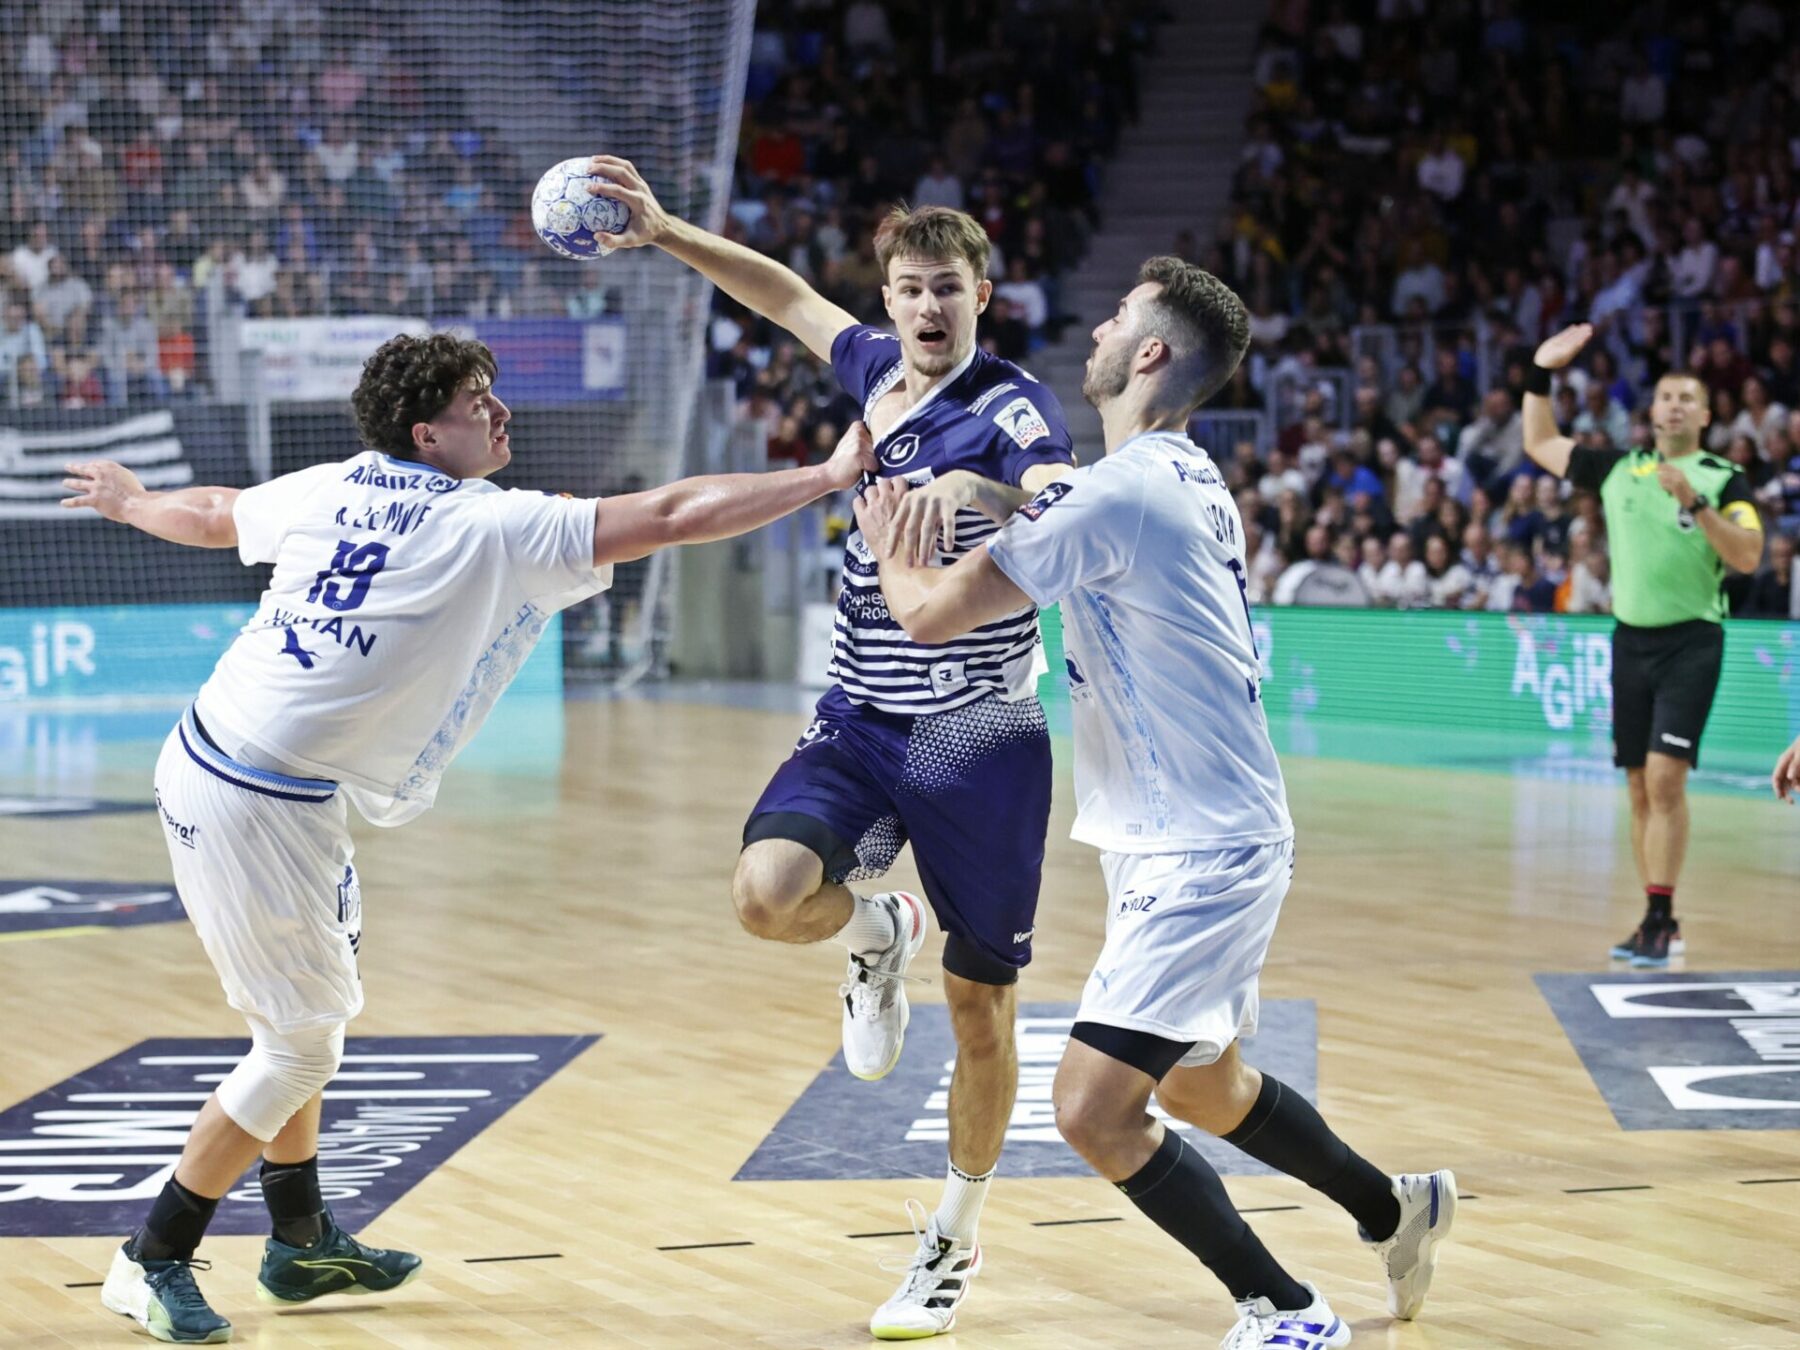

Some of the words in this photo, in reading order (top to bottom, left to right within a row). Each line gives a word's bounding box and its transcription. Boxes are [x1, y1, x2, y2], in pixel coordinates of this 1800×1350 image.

[344, 464, 422, 490] Allianz
[305, 540, 391, 611] 19
[1512, 628, 1614, 729] AGiR
